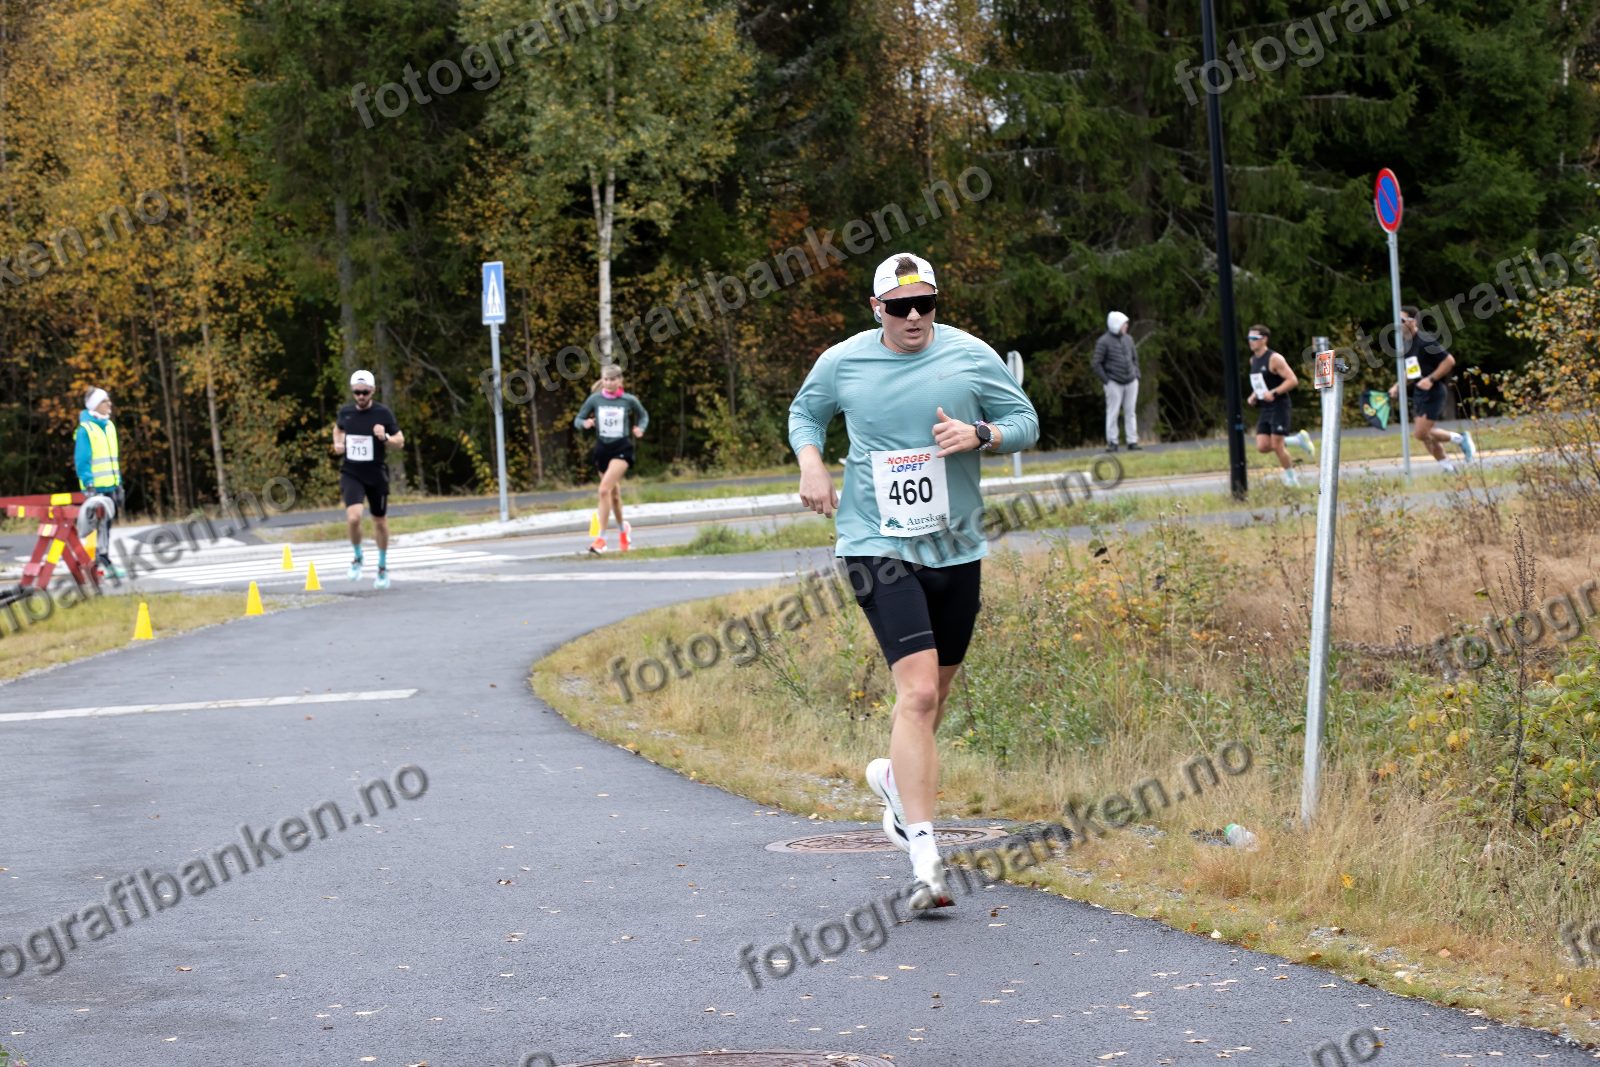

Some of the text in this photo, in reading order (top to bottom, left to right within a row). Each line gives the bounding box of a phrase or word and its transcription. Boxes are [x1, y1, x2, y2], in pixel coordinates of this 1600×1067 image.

[351, 445, 367, 456] 713
[887, 453, 931, 465] NORGES
[889, 477, 933, 506] 460
